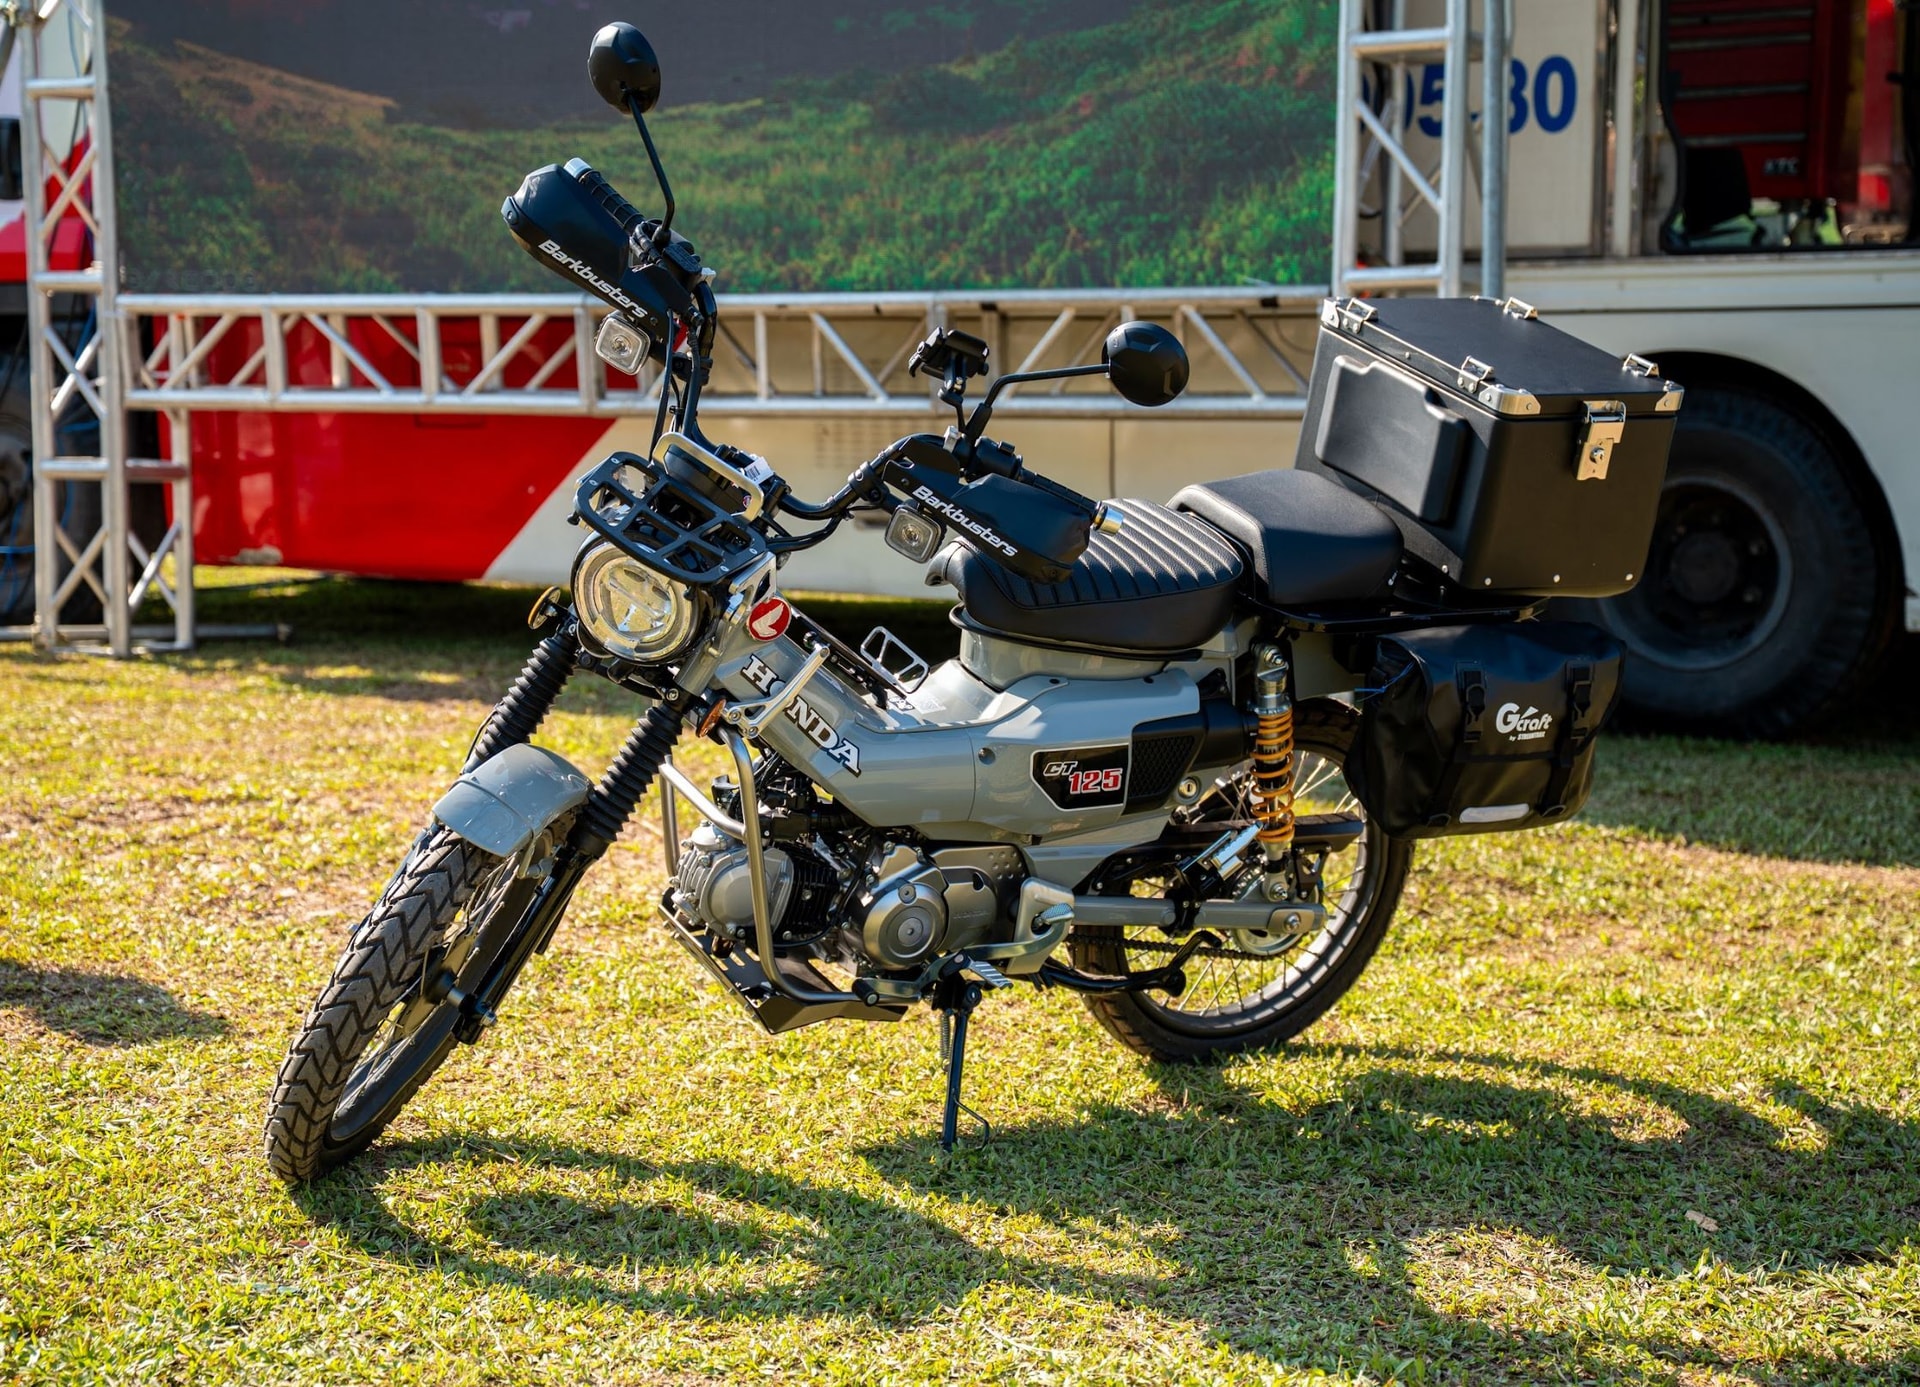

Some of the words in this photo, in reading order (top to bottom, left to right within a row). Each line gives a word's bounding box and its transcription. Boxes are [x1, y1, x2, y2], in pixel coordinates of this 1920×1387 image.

[538, 239, 648, 319] Barkbusters
[912, 485, 1018, 557] Barkbusters
[1043, 761, 1078, 776] CT
[1068, 768, 1123, 795] 125
